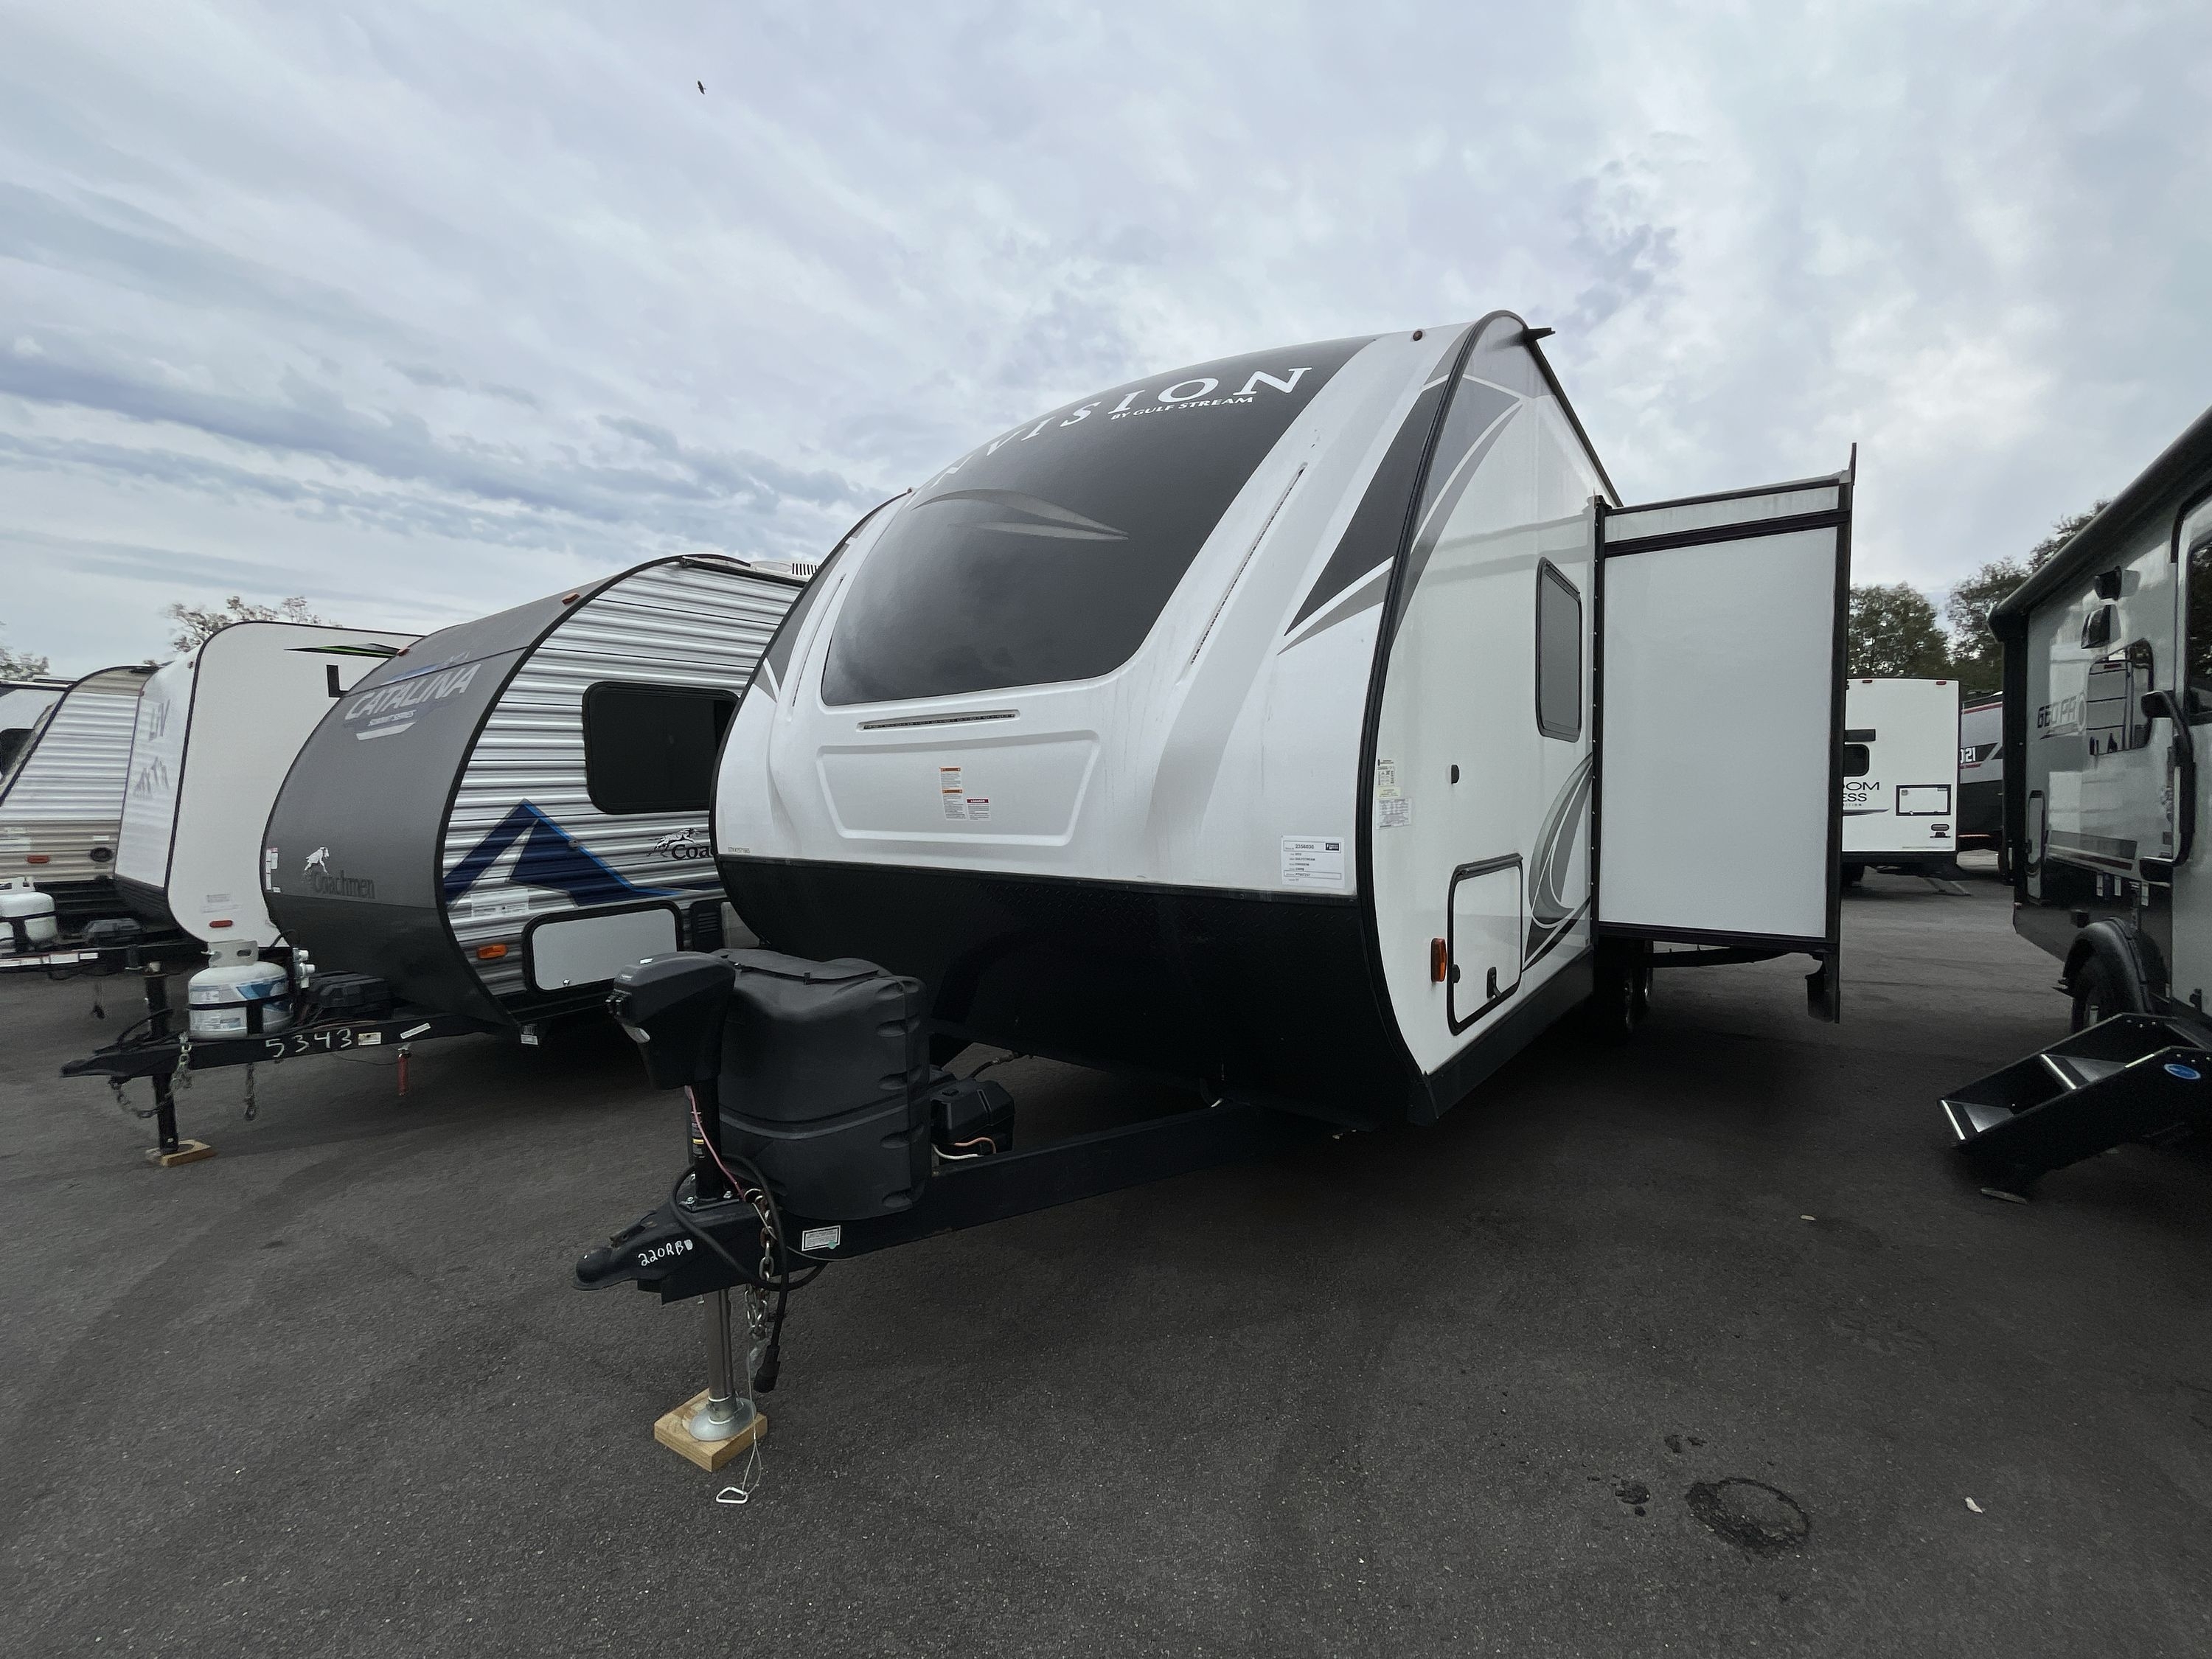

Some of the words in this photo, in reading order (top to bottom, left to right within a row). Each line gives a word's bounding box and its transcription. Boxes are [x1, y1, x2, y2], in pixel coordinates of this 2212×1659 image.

[1110, 411, 1131, 420] BY
[1133, 404, 1175, 416] GULF
[1178, 397, 1254, 409] STREAM
[344, 664, 482, 720] CATALINA
[1843, 782, 1880, 791] OM
[265, 1027, 353, 1057] 5343
